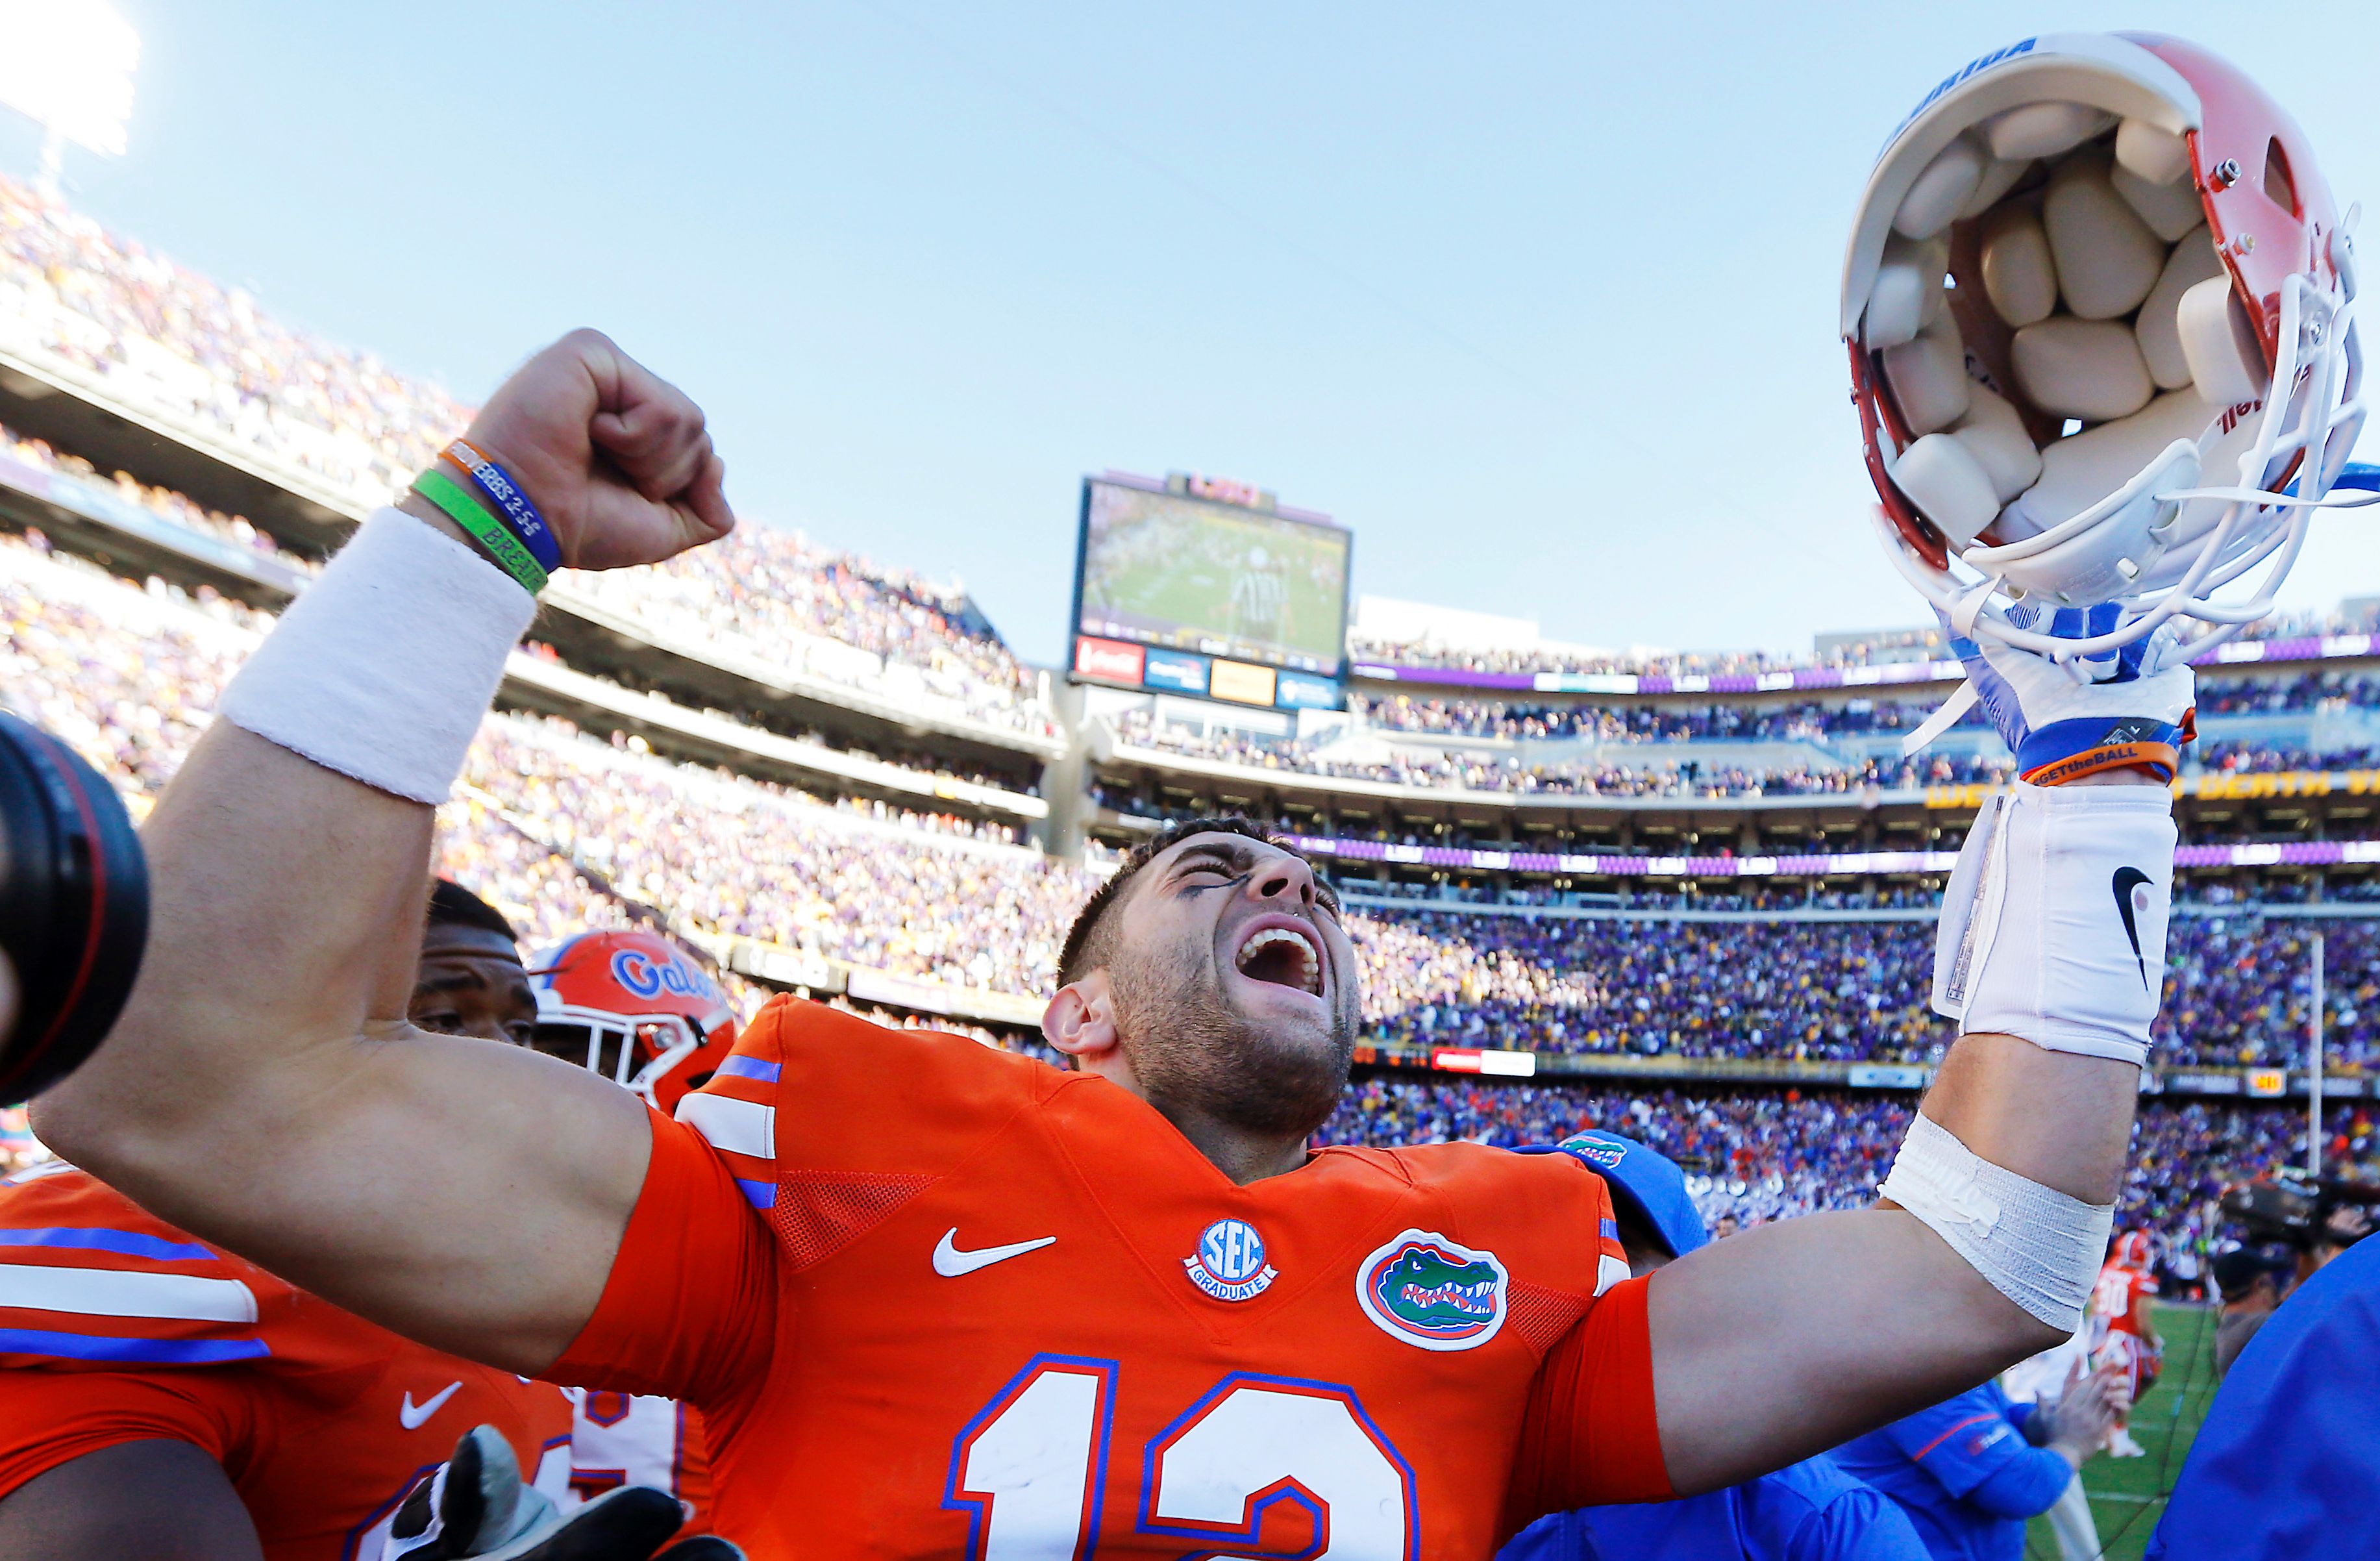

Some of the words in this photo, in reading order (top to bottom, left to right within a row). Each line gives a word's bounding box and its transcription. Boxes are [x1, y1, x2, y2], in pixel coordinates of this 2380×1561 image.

[1204, 1221, 1260, 1279] SEC
[1193, 1269, 1265, 1299] GRADUATE
[941, 1353, 1419, 1561] 12
